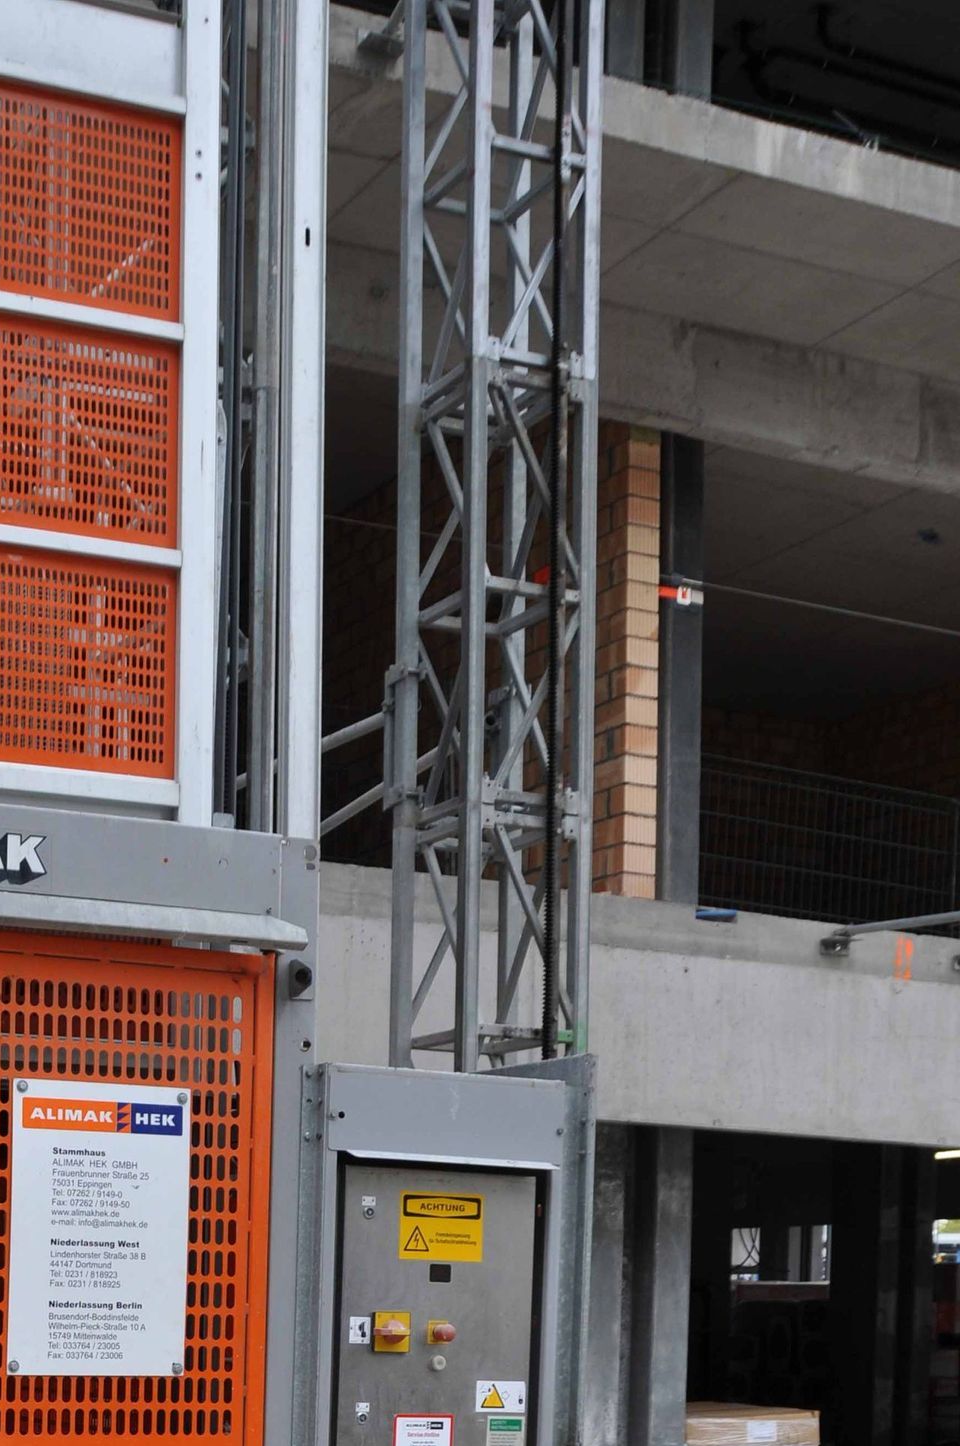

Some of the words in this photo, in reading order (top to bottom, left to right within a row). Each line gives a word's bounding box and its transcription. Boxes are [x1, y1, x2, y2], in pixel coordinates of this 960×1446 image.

[30, 1107, 113, 1123] ALIMAK
[135, 1112, 176, 1127] HEK
[52, 1147, 106, 1157] Stammhaus
[52, 1158, 84, 1167] ALIMAK
[89, 1159, 107, 1168] HEK
[112, 1160, 138, 1169] GMBH
[52, 1168, 110, 1178] Frauenbrunner
[112, 1170, 137, 1180] Straße
[139, 1172, 150, 1181] 25
[52, 1178, 75, 1187] 75031
[77, 1179, 112, 1190] Eppingen
[96, 1190, 123, 1199] 9149-0
[99, 1200, 130, 1209] 9149-50
[420, 1203, 466, 1212] ACHTUNG
[51, 1208, 120, 1218] www.alimakhek.de
[78, 1219, 148, 1229] info@alimakhek.de
[50, 1238, 115, 1250] Niederlassung
[117, 1239, 140, 1248] West
[50, 1250, 101, 1259] Lindenhorster
[103, 1251, 128, 1260] Straße
[49, 1260, 73, 1268] 44147
[75, 1260, 112, 1269] Dortmund
[64, 1270, 84, 1278] 0231
[67, 1279, 86, 1288] 0231
[48, 1300, 114, 1311] Niederlassung
[116, 1301, 143, 1310] Berlin
[130, 1323, 139, 1331] 10
[140, 1323, 146, 1331] A
[48, 1332, 72, 1340] 15749
[73, 1332, 118, 1341] Mittenwalde
[97, 1342, 121, 1350] 23005
[100, 1351, 124, 1360] 23006
